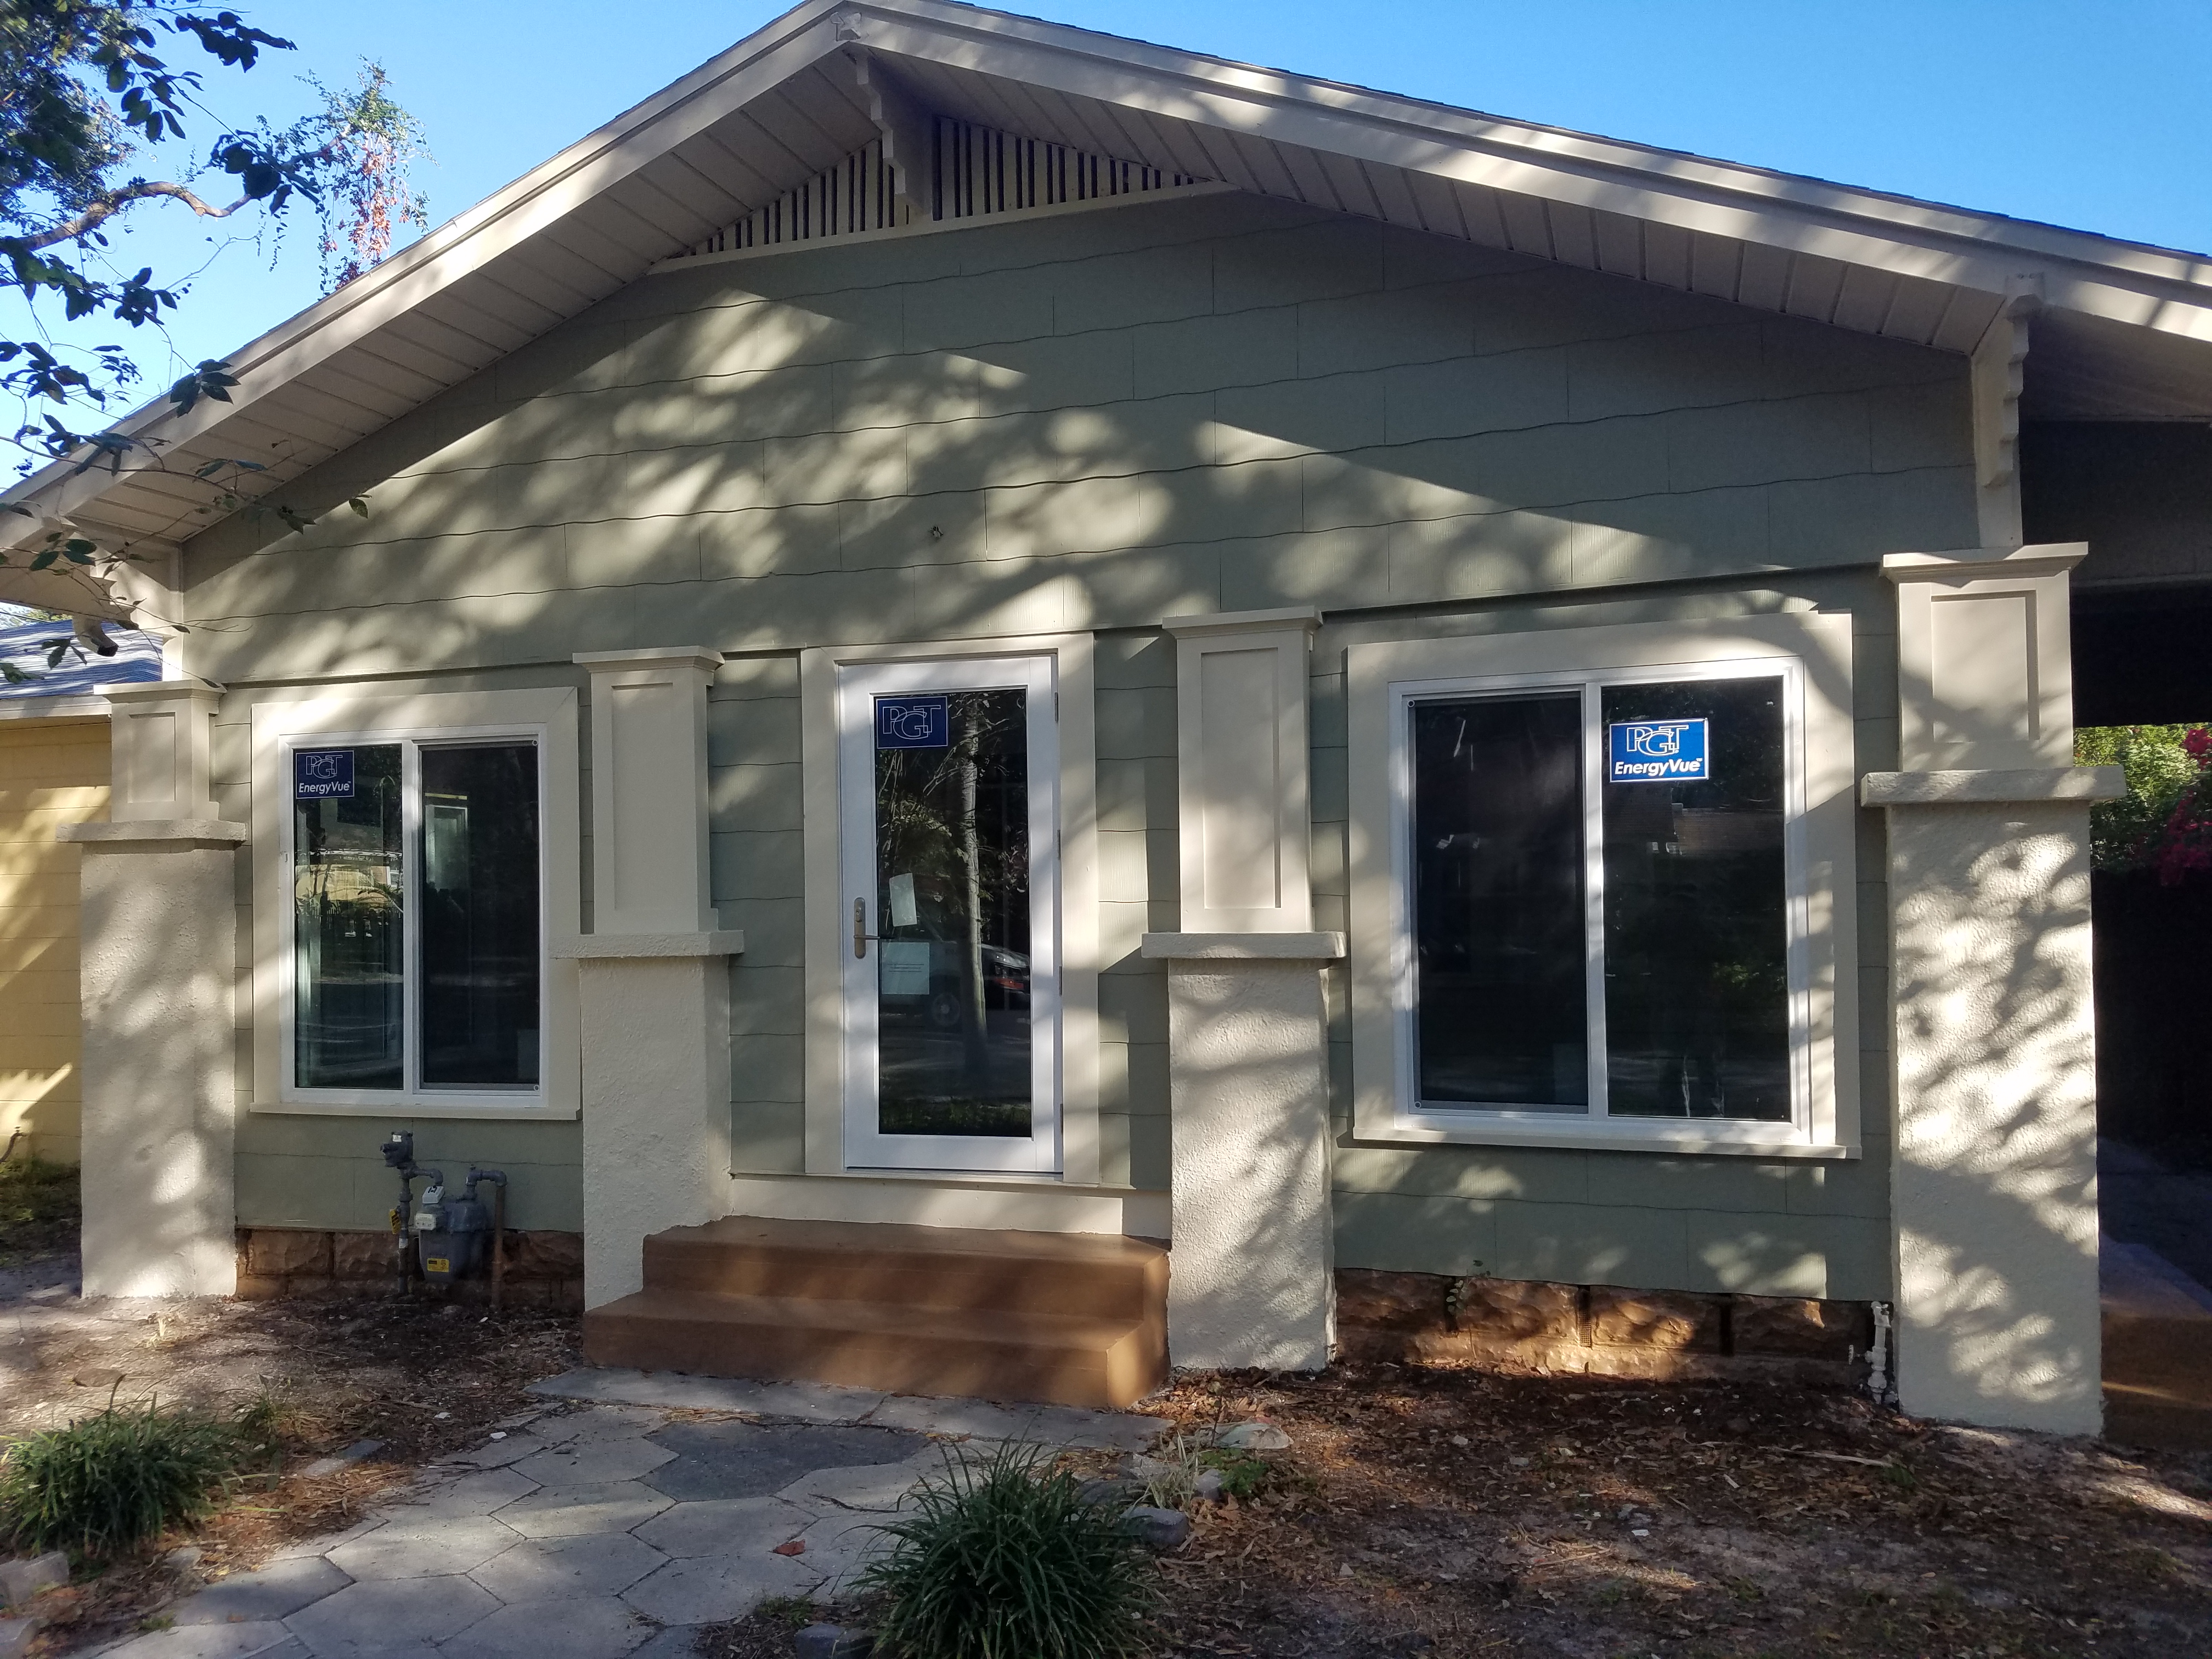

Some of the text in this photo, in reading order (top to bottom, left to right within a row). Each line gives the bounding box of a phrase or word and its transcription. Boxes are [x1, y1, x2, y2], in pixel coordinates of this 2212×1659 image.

[882, 704, 941, 740] PGT
[1626, 725, 1689, 757] PGT
[306, 754, 343, 779] PGT
